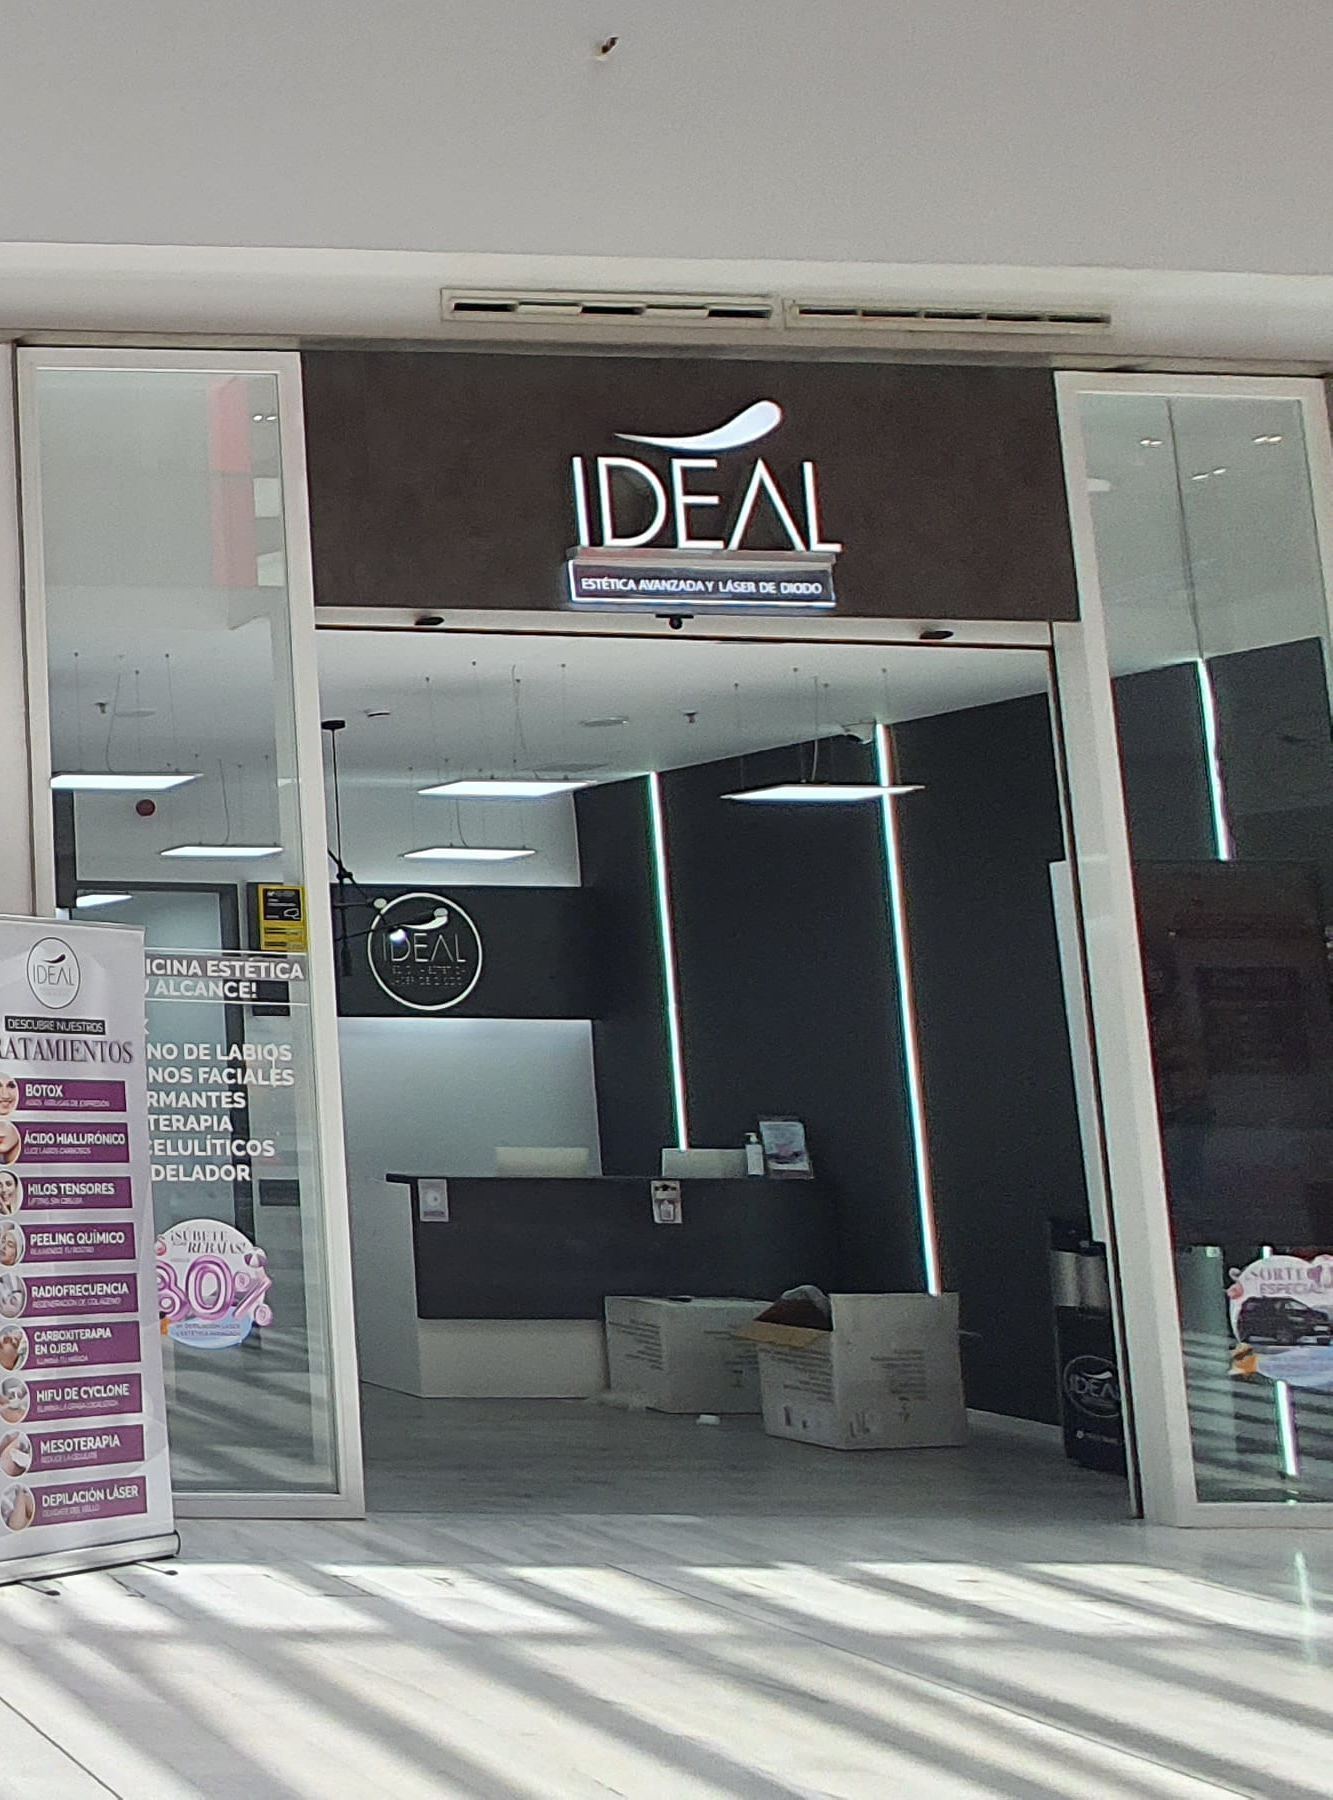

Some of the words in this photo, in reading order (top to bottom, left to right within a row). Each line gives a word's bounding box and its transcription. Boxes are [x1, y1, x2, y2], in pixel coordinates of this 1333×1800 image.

[571, 456, 844, 554] IDEAL
[581, 577, 637, 591] ESTÉTICA
[638, 578, 704, 592] AVANZADA
[704, 580, 714, 592] Y
[719, 578, 756, 593] LÁSER
[759, 582, 776, 594] DE
[780, 582, 823, 595] DIODO
[381, 932, 467, 963] IDEAL
[33, 964, 75, 987] IDEAL
[146, 958, 203, 976] ICINA
[206, 957, 304, 980] ESTÉTICA
[154, 980, 258, 999] ALCANCE!
[7, 1018, 55, 1031] DESCUBRE
[56, 1021, 104, 1033] NUESTROS
[147, 1043, 178, 1060] NO
[183, 1043, 212, 1060] DE
[216, 1043, 293, 1061] LABIOS
[148, 1067, 193, 1083] NOS
[198, 1068, 294, 1086] FACIALES
[25, 1084, 63, 1097] BOTOX
[147, 1091, 246, 1108] RMANTES
[148, 1114, 234, 1131] TERAPIA
[24, 1130, 55, 1145] ÁCIDO
[56, 1130, 126, 1145] HIALURÓNICO
[149, 1134, 276, 1157] ELULÍTICOS
[151, 1164, 251, 1182] DELADOR
[27, 1183, 59, 1196] HILOS
[59, 1182, 115, 1195] TENSORES
[30, 1233, 75, 1246] PEELING
[76, 1229, 125, 1245] QUÍMICO
[31, 1282, 130, 1298] RADIOFRECUENCIA
[34, 1327, 112, 1342] CARBOXITERAPIA
[35, 1344, 48, 1355] EN
[49, 1343, 79, 1354] OJERA
[36, 1388, 62, 1402] HIFU
[64, 1387, 78, 1400] DE
[80, 1384, 130, 1399] CYCLONE
[1070, 1374, 1120, 1399] IDEA
[40, 1434, 121, 1455] MESOTERAPIA
[42, 1487, 105, 1507] DEPILACIÓN
[106, 1484, 138, 1500] LÁSER
